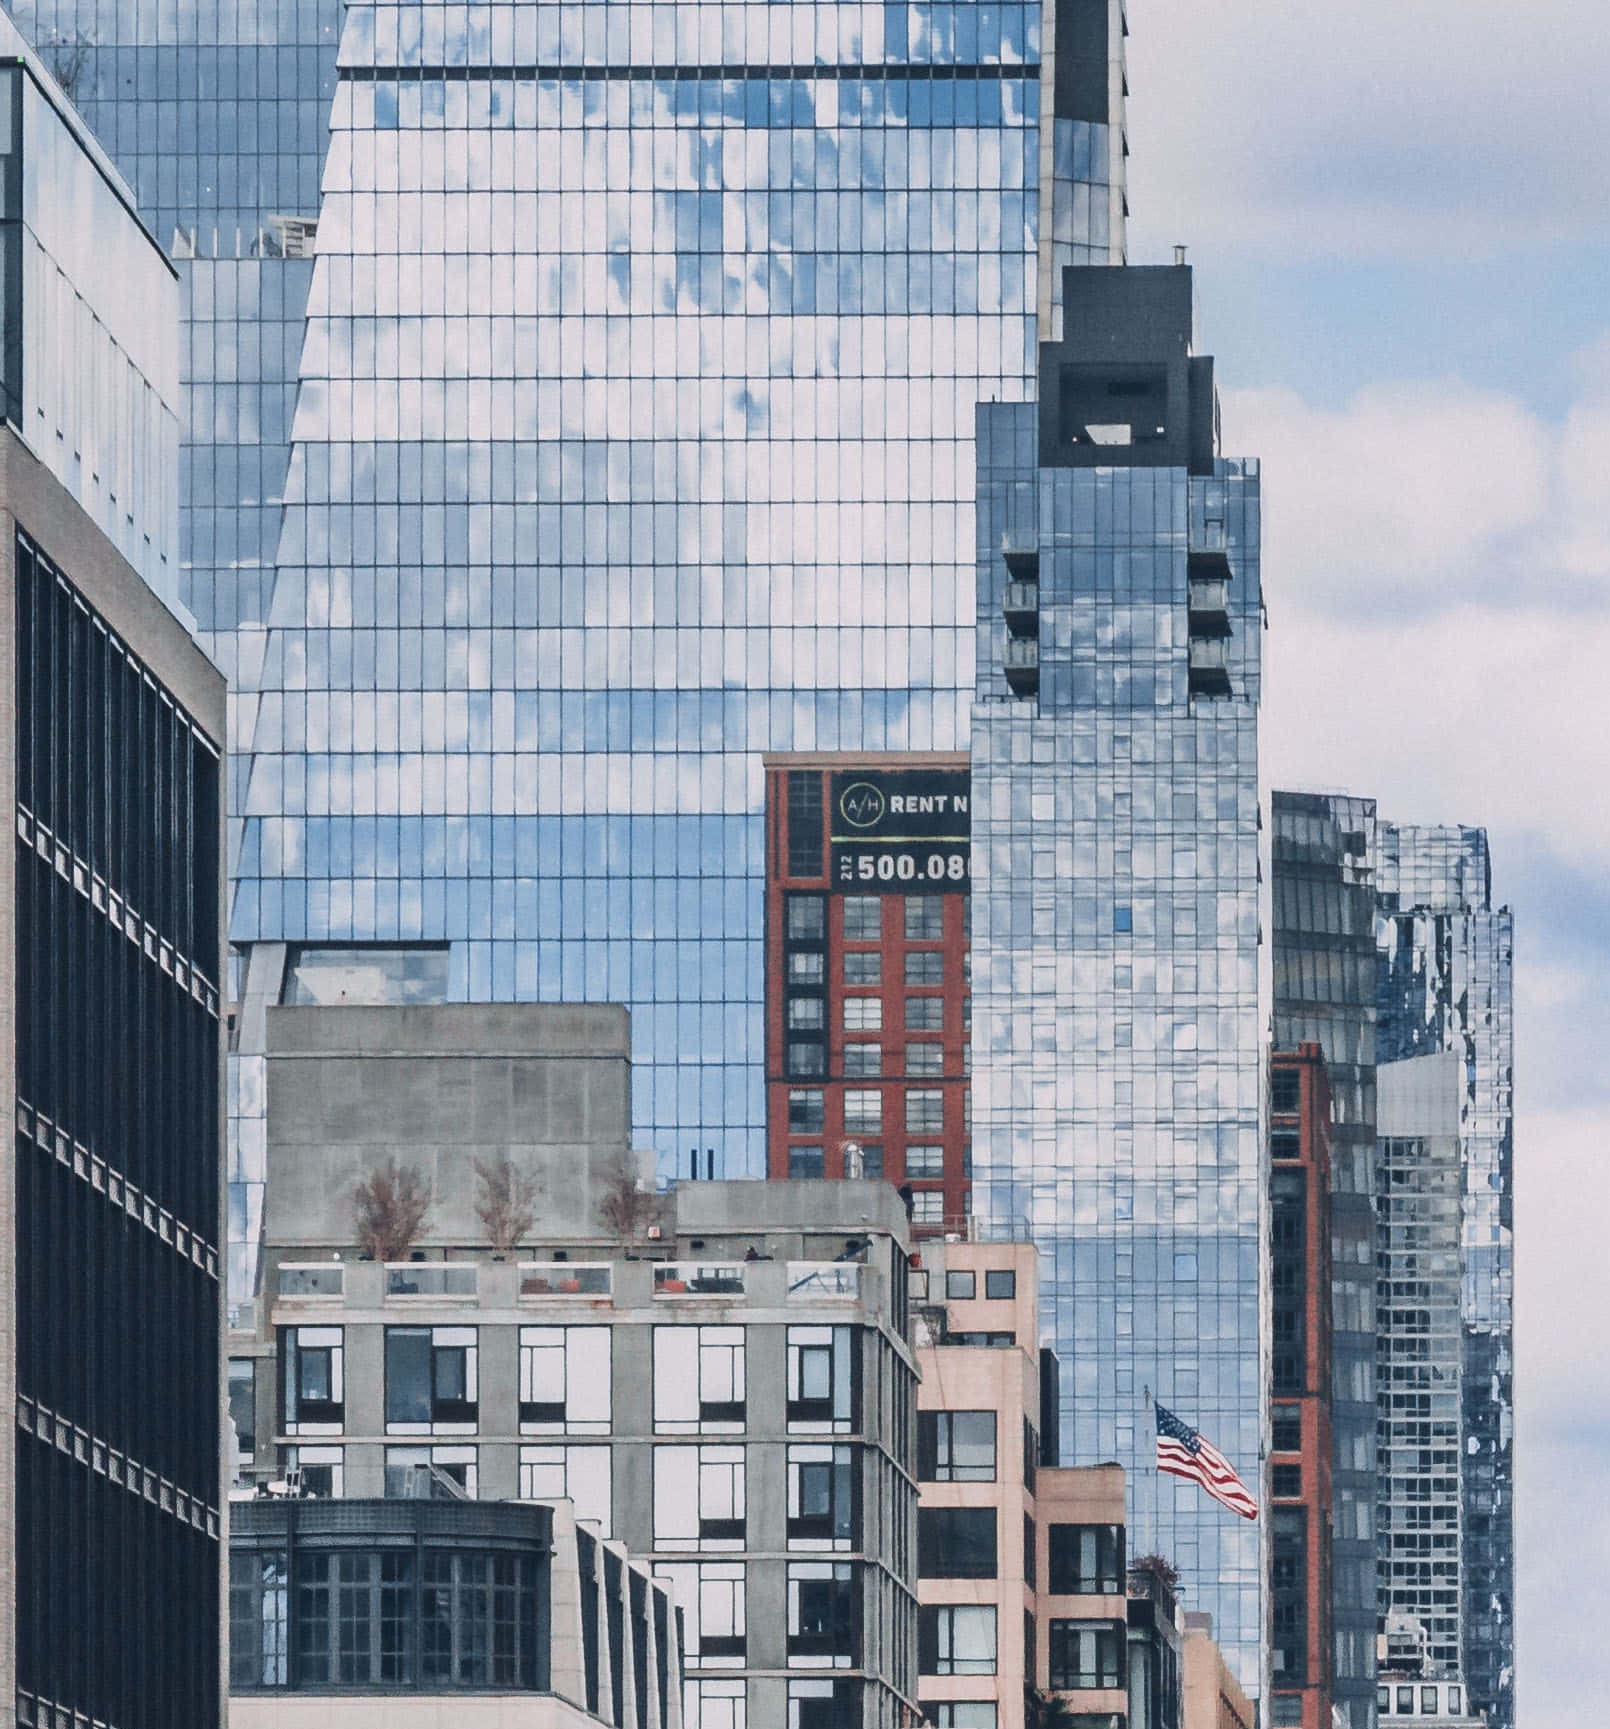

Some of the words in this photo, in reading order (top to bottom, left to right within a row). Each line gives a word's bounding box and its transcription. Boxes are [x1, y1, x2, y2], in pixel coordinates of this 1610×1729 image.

[890, 795, 948, 813] RENT
[840, 855, 853, 881] 212
[857, 854, 971, 881] 500.08
